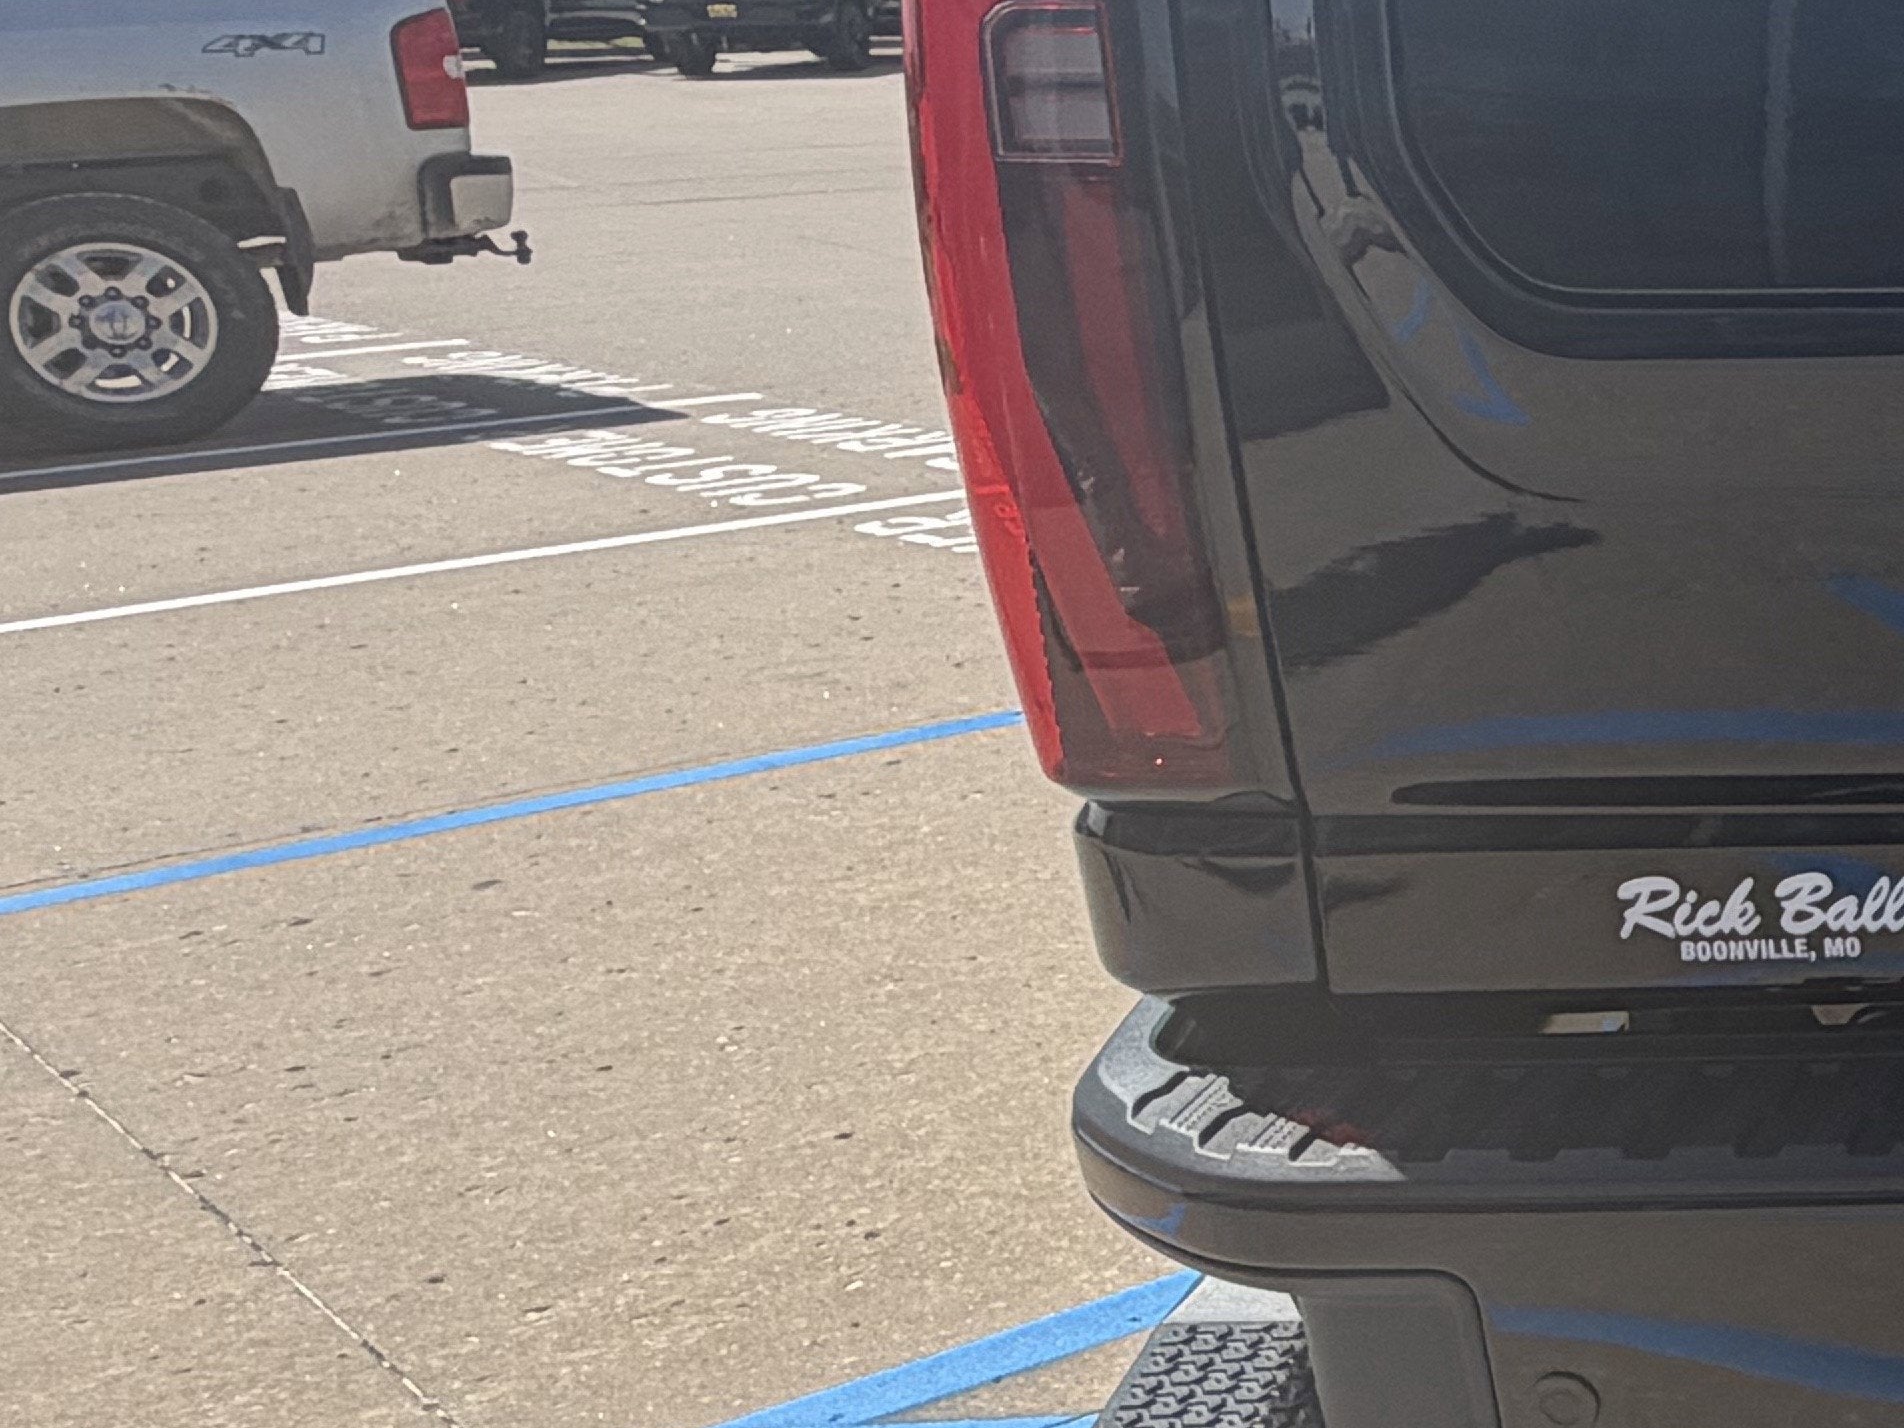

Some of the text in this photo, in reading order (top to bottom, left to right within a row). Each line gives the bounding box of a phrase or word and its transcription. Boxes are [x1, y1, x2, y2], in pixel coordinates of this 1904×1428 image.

[1616, 875, 1762, 940] Rick
[1680, 936, 1862, 963] BOONVILLE, MO
